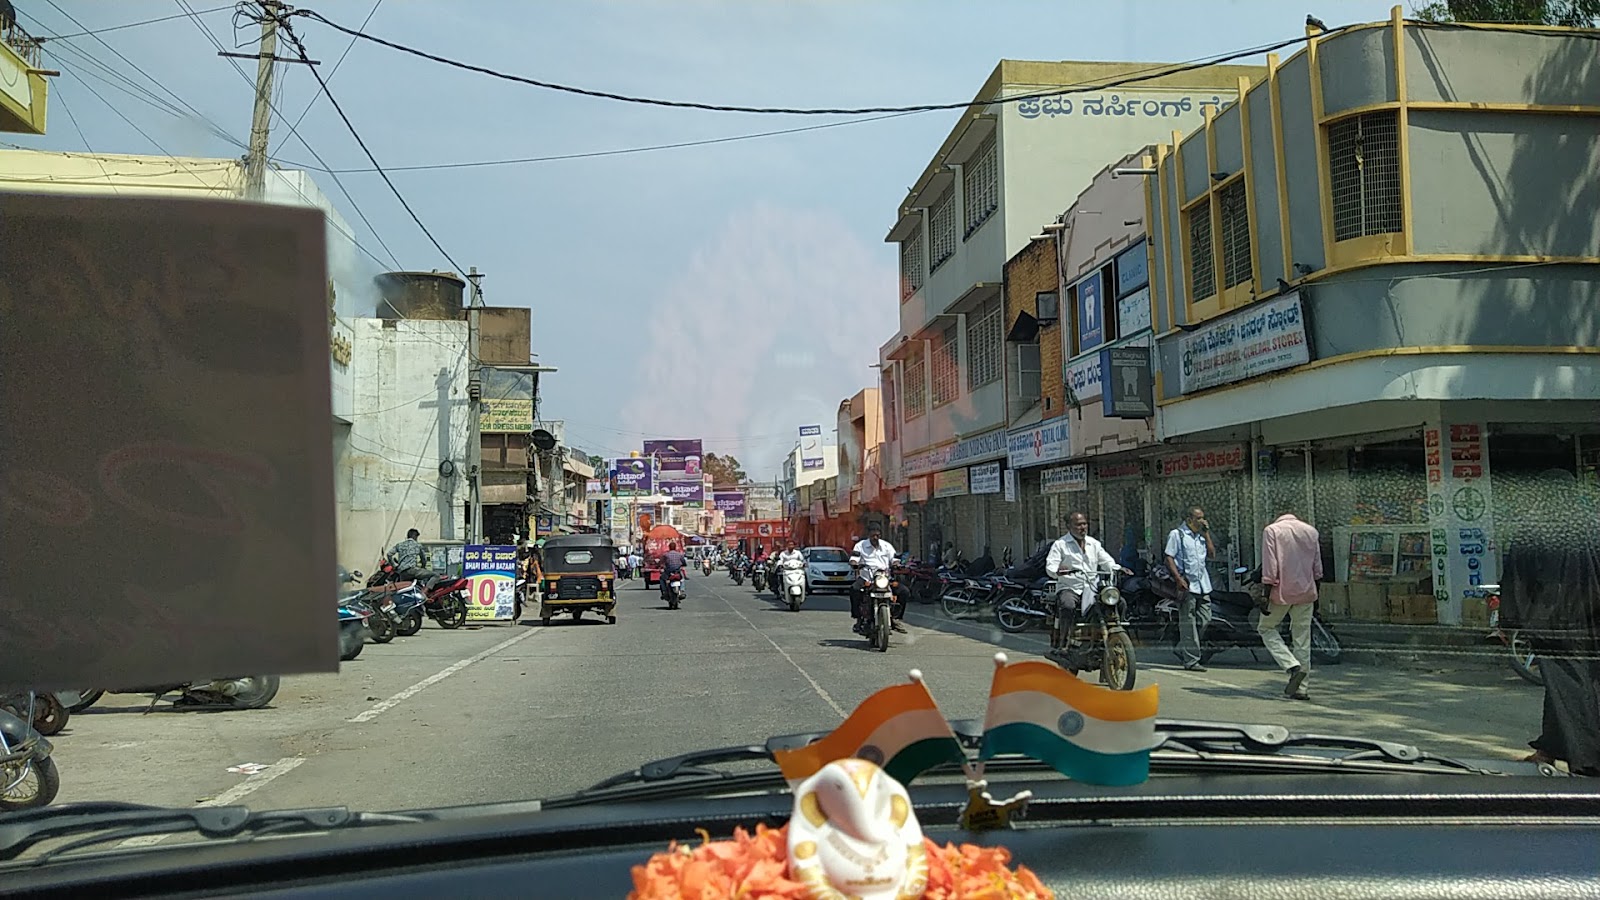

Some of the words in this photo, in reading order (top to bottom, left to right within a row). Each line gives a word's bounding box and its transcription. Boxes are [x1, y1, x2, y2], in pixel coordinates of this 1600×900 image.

[1018, 95, 1073, 119] ಪ್ರಭು
[1083, 95, 1192, 118] ನರ್ಸಿಂಗ್
[1121, 264, 1142, 284] CLINIC
[1213, 350, 1241, 369] MEDICAL
[1272, 331, 1303, 351] STORES
[993, 430, 1007, 451] HOM
[481, 562, 495, 570] DELHI
[496, 562, 515, 570] BAZAAR
